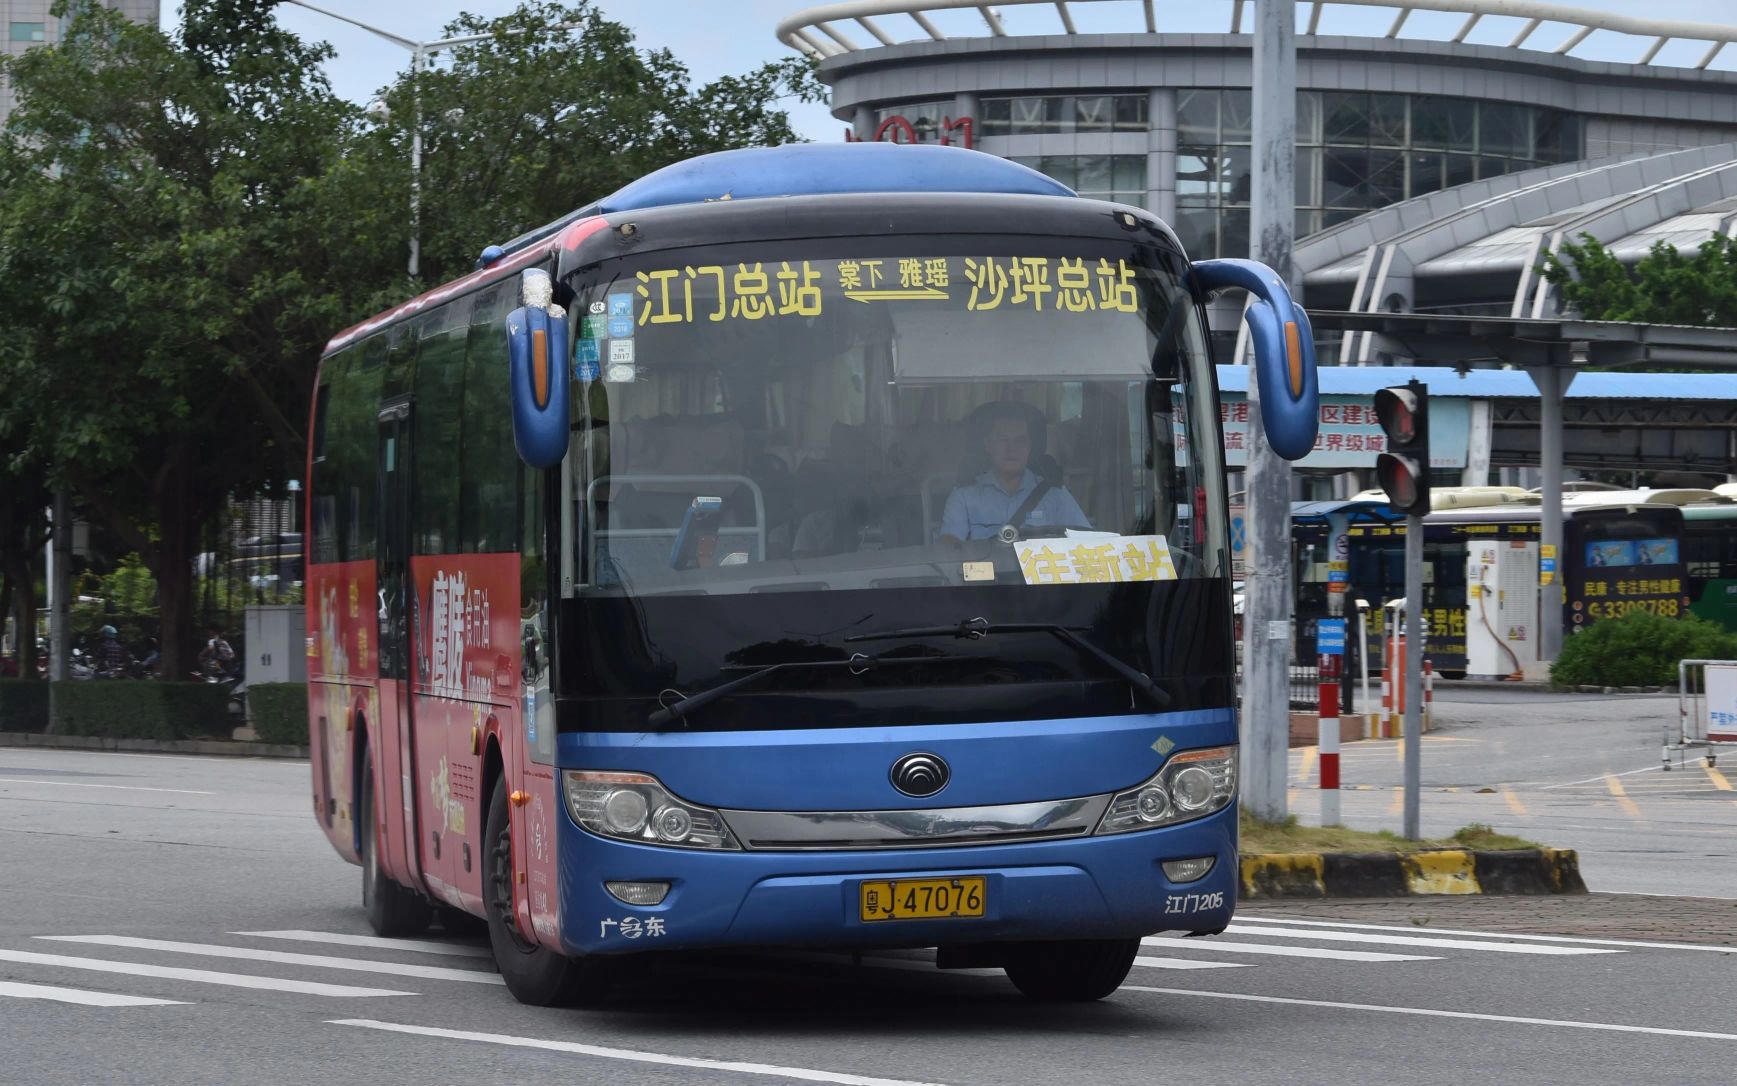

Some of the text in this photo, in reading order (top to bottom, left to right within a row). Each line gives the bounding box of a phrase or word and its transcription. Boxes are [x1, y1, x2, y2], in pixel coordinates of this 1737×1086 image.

[635, 260, 822, 326] 江门总站
[837, 258, 949, 290] 棠下 雅瑶
[965, 257, 1139, 313] 沙坪总站
[1020, 541, 1177, 584] 往新站
[466, 587, 490, 650] 食用油
[1164, 891, 1224, 915] 江门205
